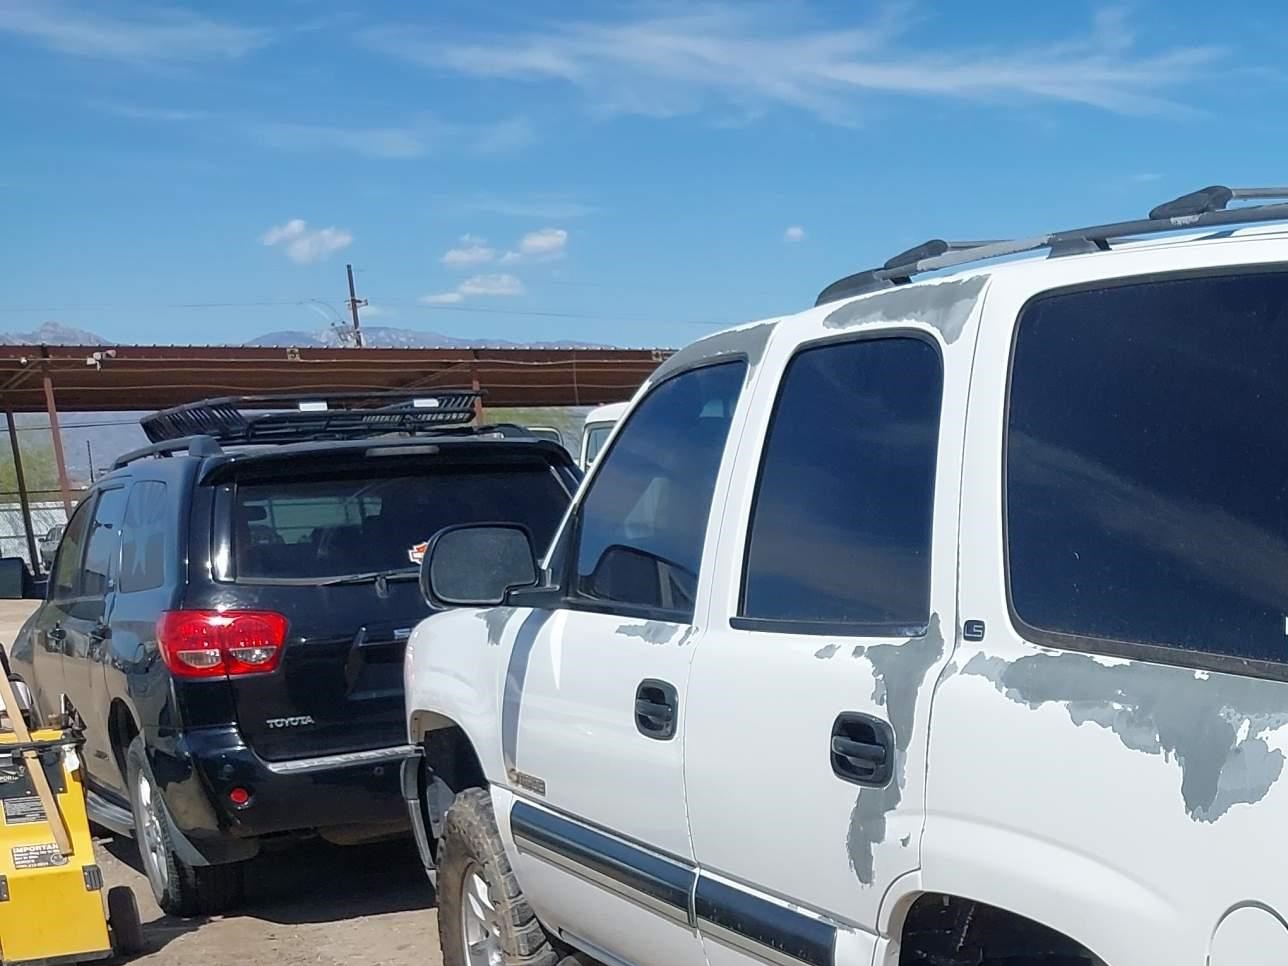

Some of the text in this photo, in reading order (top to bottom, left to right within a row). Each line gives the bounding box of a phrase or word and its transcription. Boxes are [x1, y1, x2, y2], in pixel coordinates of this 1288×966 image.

[964, 623, 983, 638] LS
[266, 715, 315, 729] TOYOTA
[13, 843, 59, 853] IMPORTAN
